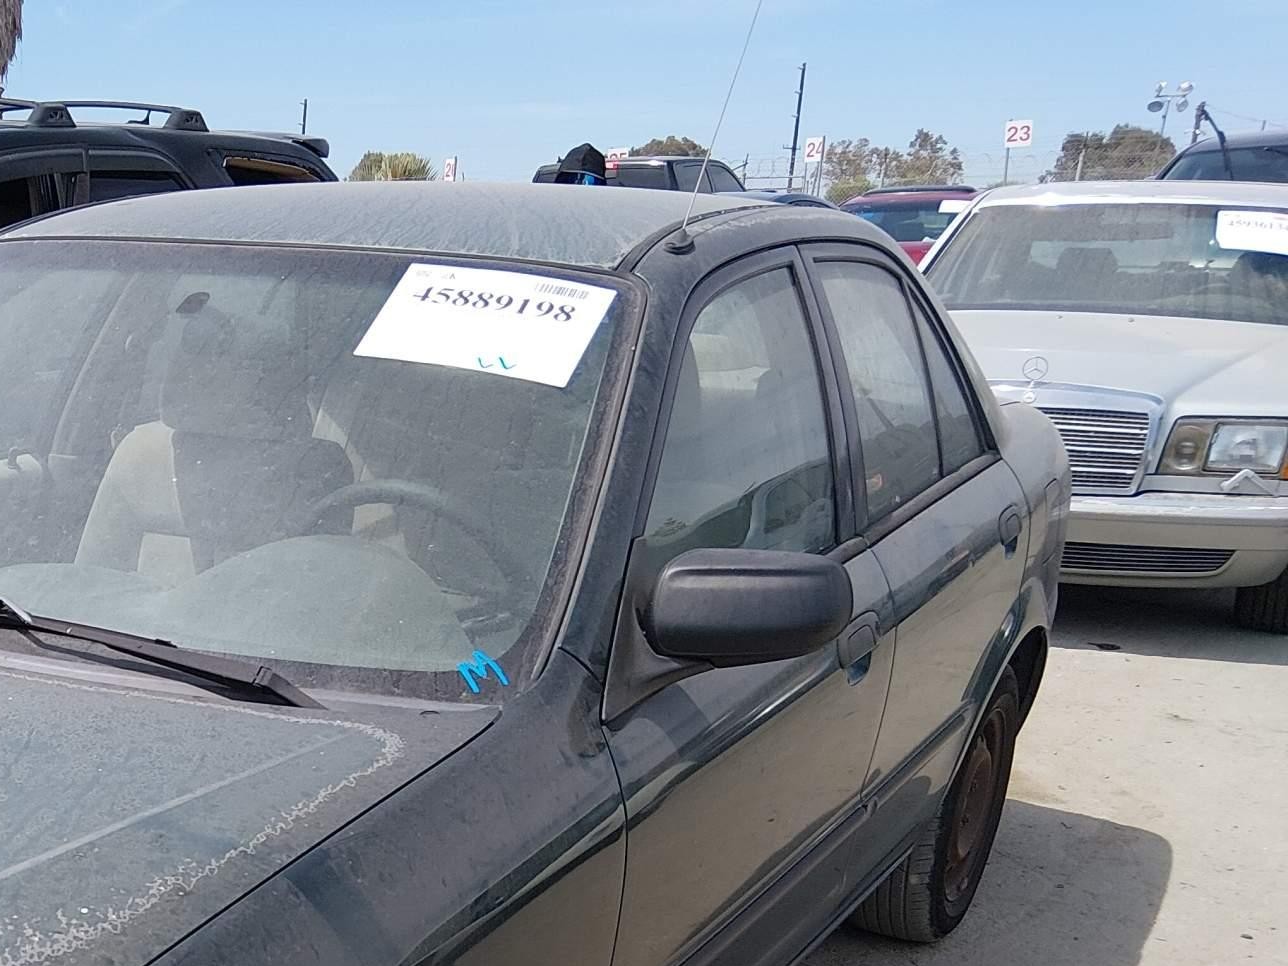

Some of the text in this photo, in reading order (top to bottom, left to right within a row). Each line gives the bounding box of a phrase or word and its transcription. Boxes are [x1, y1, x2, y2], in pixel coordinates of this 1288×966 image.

[1007, 125, 1031, 142] 23
[413, 286, 576, 322] 45889198
[456, 649, 510, 694] M
